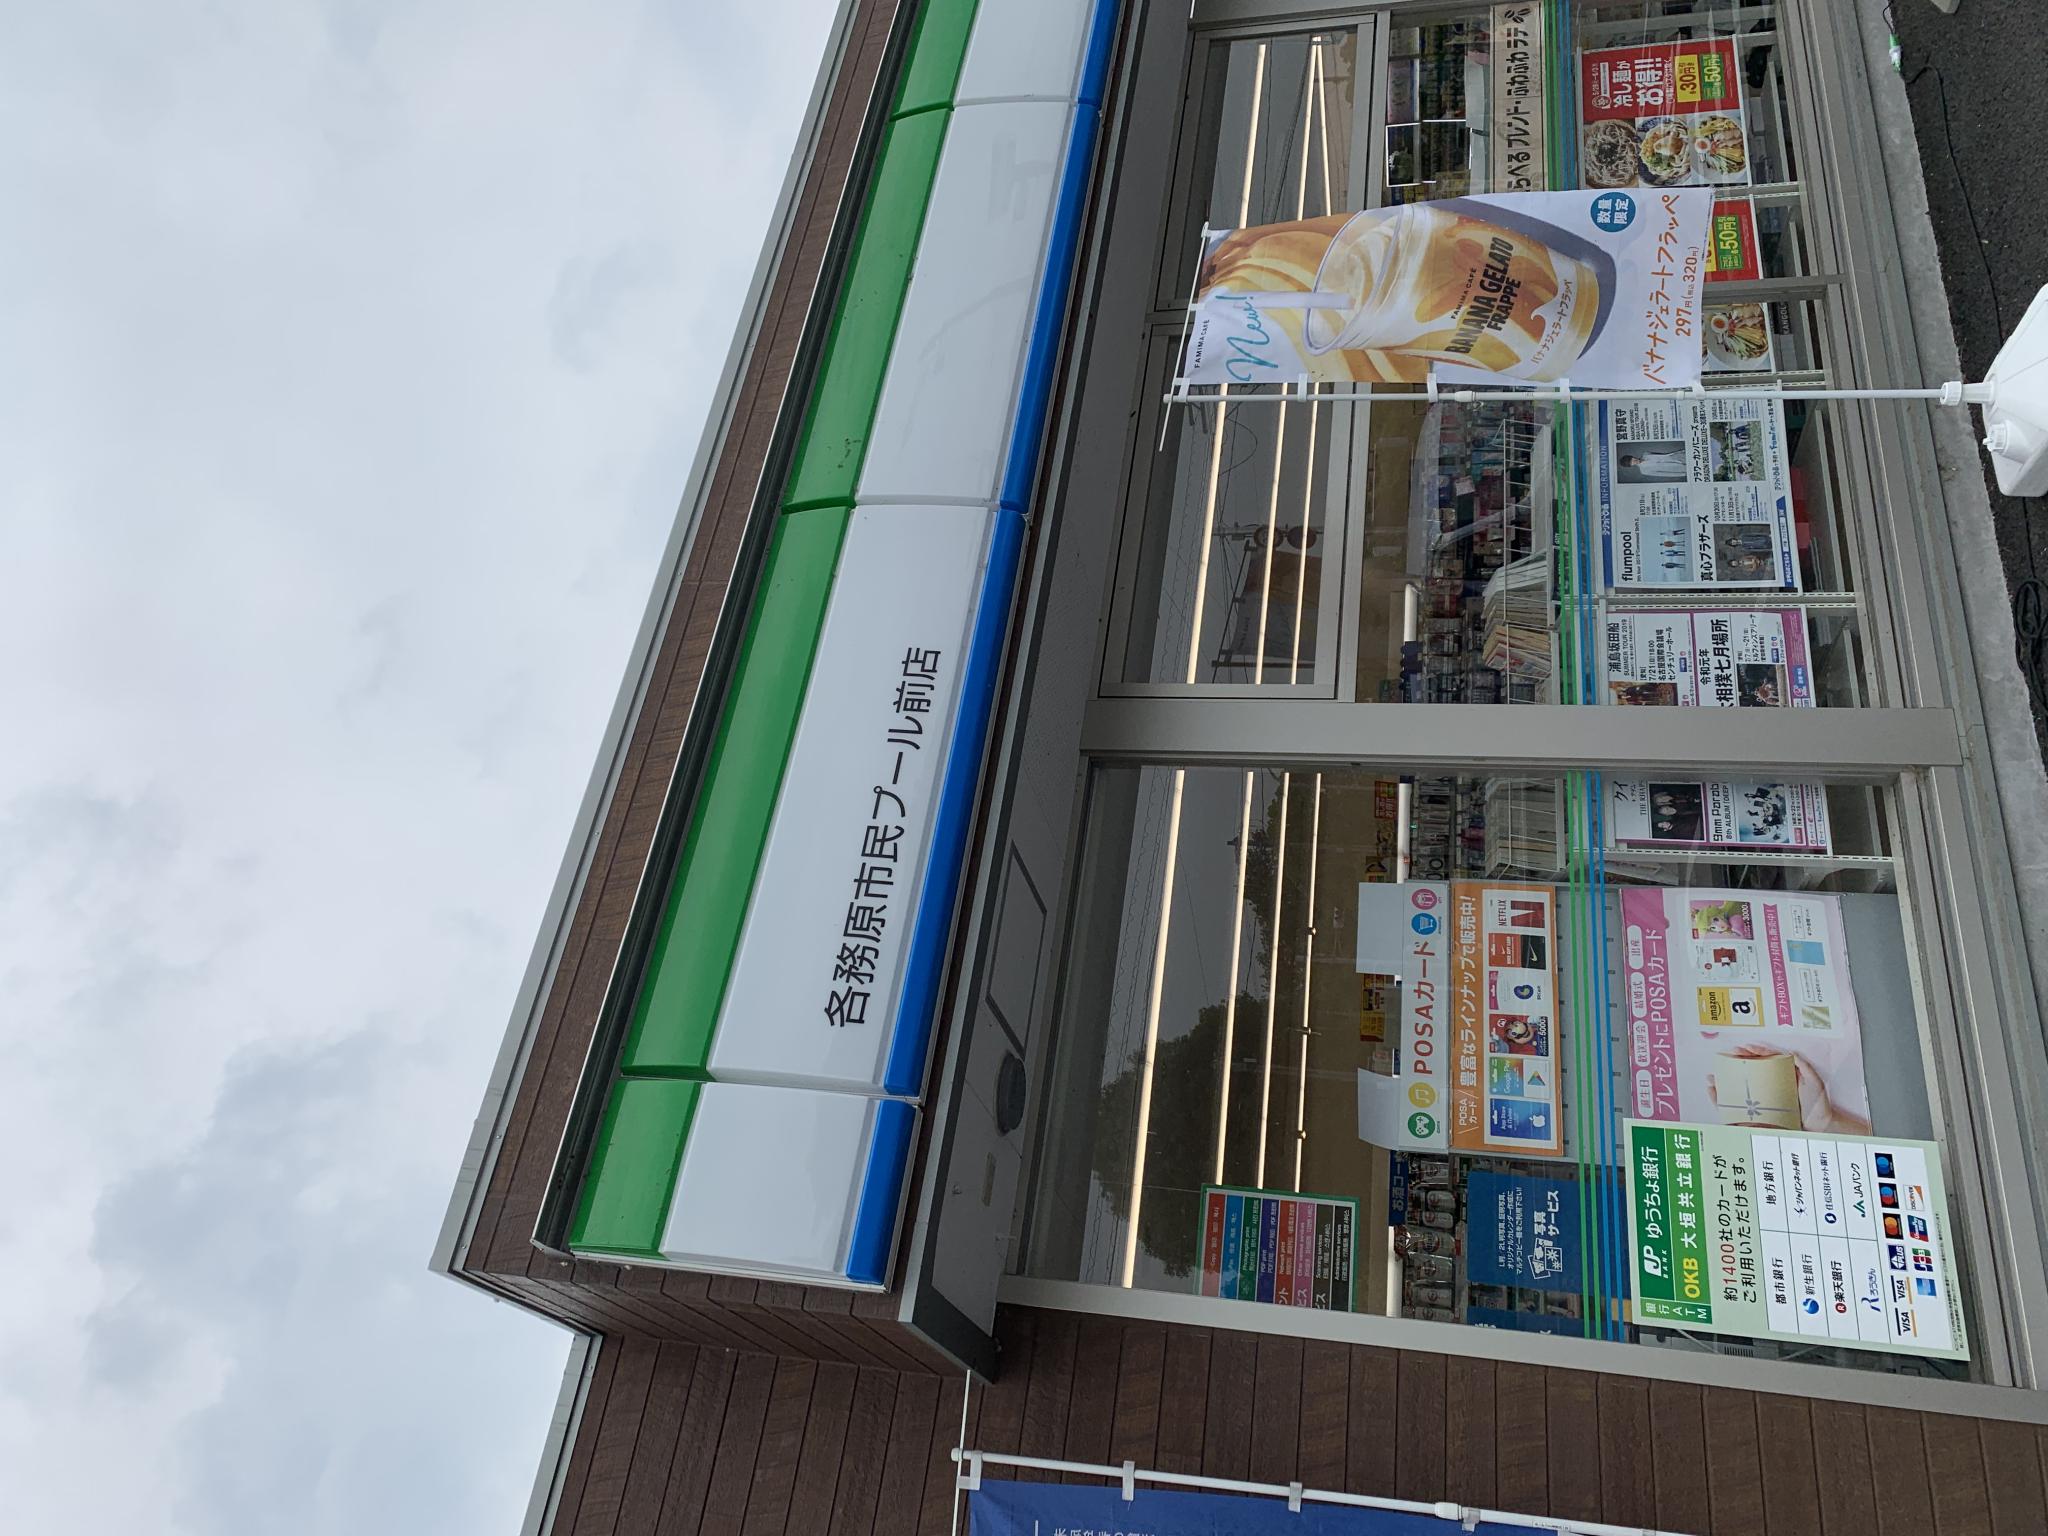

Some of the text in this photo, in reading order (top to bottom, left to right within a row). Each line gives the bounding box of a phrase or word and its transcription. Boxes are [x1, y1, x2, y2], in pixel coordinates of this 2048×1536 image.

[1612, 61, 1633, 107] 冷し麺が
[1635, 57, 1664, 106] お得!!
[1596, 198, 1613, 224] 数量
[1613, 197, 1630, 225] 限定
[1445, 236, 1515, 354] BANANA GELATO
[1450, 290, 1470, 320] FAMIMA
[1486, 276, 1522, 331] FRAPPE
[1642, 194, 1681, 385] バナナジェラートフラッペ
[1215, 294, 1279, 382] New!
[1531, 278, 1573, 364] バナナジェラートフラッペ
[1193, 336, 1206, 369] FAMIMA
[1615, 409, 1628, 440] 宮野真守
[1600, 445, 1609, 502] INFORMATION
[1691, 425, 1702, 482] フラワーカンパニーズ
[1620, 532, 1634, 581] flumpool
[1697, 514, 1714, 582] 真心ブラザーズ
[1607, 623, 1621, 672] 浦島坂田船
[1656, 629, 1666, 681] 名古屋国際会議場
[1666, 626, 1675, 681] センチュリーホール
[1750, 614, 1759, 662] ドルフィンズアリーナ
[1699, 648, 1711, 685] 令和元年
[1710, 784, 1723, 841] 9mm Parab
[822, 646, 942, 1029] 各務原市民プール前店
[1498, 900, 1507, 926] NETFLIX
[1511, 901, 1544, 928] N
[1630, 939, 1640, 956] 出産
[1413, 940, 1435, 1075] POSAカード
[1459, 895, 1477, 1087] 豊富なラインナップで販売中!
[1633, 981, 1643, 1009] 結婚式
[1708, 991, 1719, 1021] amazon
[1731, 1000, 1751, 1014] a
[1636, 1024, 1648, 1063] 歓送迎会
[1646, 929, 1676, 1115] プレゼントにPOSAカード
[1459, 1098, 1468, 1126] POSA
[1468, 1101, 1478, 1124] カード
[1640, 1079, 1650, 1109] 誕生日
[1391, 1151, 1405, 1211] お酒コー
[1641, 1146, 1663, 1239] ゆうちょ銀行
[1674, 1134, 1698, 1249] 大垣共立銀行
[1762, 1160, 1777, 1205] 地方銀行
[1790, 1152, 1805, 1205] ジャパンネット銀行
[1819, 1151, 1834, 1211] 住信SBIネット銀行
[1850, 1162, 1863, 1198] JAバンク
[1908, 1186, 1917, 1210] DISCOVER
[1534, 1211, 1546, 1235] 写真
[1547, 1190, 1559, 1236] サービス
[1712, 1154, 1738, 1302] 約1400社のカードが
[1731, 1156, 1757, 1304] ご利用いただけます。
[1643, 1245, 1662, 1276] JP
[1682, 1257, 1701, 1298] OKB
[1801, 1254, 1816, 1296] 新生銀行
[1895, 1246, 1905, 1264] PLUS
[1917, 1249, 1928, 1271] JCB
[1771, 1257, 1787, 1304] 都市銀行
[1831, 1260, 1845, 1303] 楽天銀行
[1868, 1268, 1879, 1296] ろうきん
[1895, 1279, 1905, 1299] VISA
[1645, 1302, 1707, 1320] 銀行ATM
[1901, 1312, 1911, 1332] VISA
